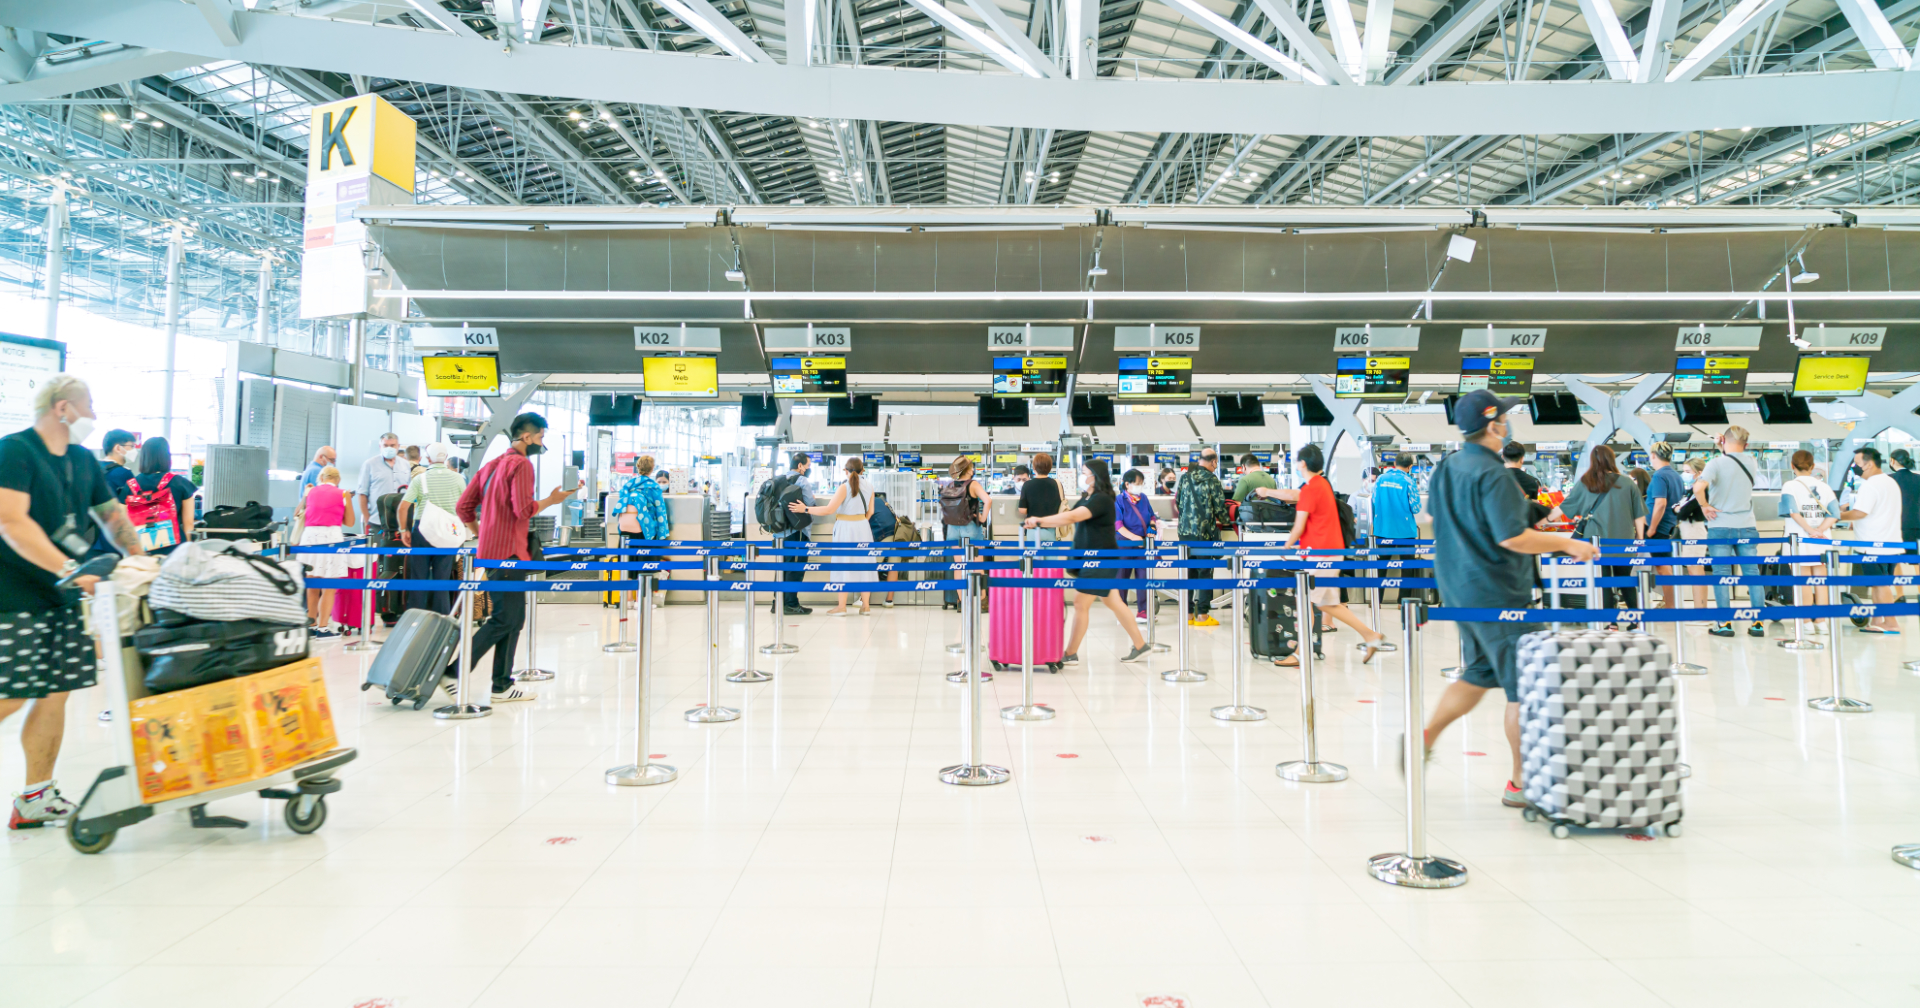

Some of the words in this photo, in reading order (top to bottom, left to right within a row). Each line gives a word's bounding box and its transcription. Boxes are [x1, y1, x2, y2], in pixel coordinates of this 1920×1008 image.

[320, 105, 358, 171] K
[465, 333, 492, 345] K01
[640, 332, 669, 344] K02
[816, 333, 845, 345] K03
[994, 332, 1023, 344] K04
[1165, 333, 1194, 344] K05
[1340, 333, 1369, 345] K06
[1510, 334, 1540, 345] K07
[1682, 333, 1711, 344] K08
[1849, 333, 1878, 344] K09
[1237, 579, 1258, 587] AOT
[1381, 579, 1402, 587] AOT
[1562, 579, 1584, 587] AOT
[1719, 577, 1740, 585] AOT
[1806, 577, 1827, 585] AOT
[1893, 576, 1914, 585] AOT
[458, 582, 481, 590] AOT
[550, 583, 573, 591] AOT
[730, 582, 753, 590] AOT
[823, 583, 846, 591] AOT
[915, 582, 938, 590] AOT
[1499, 610, 1527, 621] AOT
[1617, 611, 1644, 621] AOT
[1734, 609, 1761, 620] AOT
[1850, 606, 1877, 616] AOT
